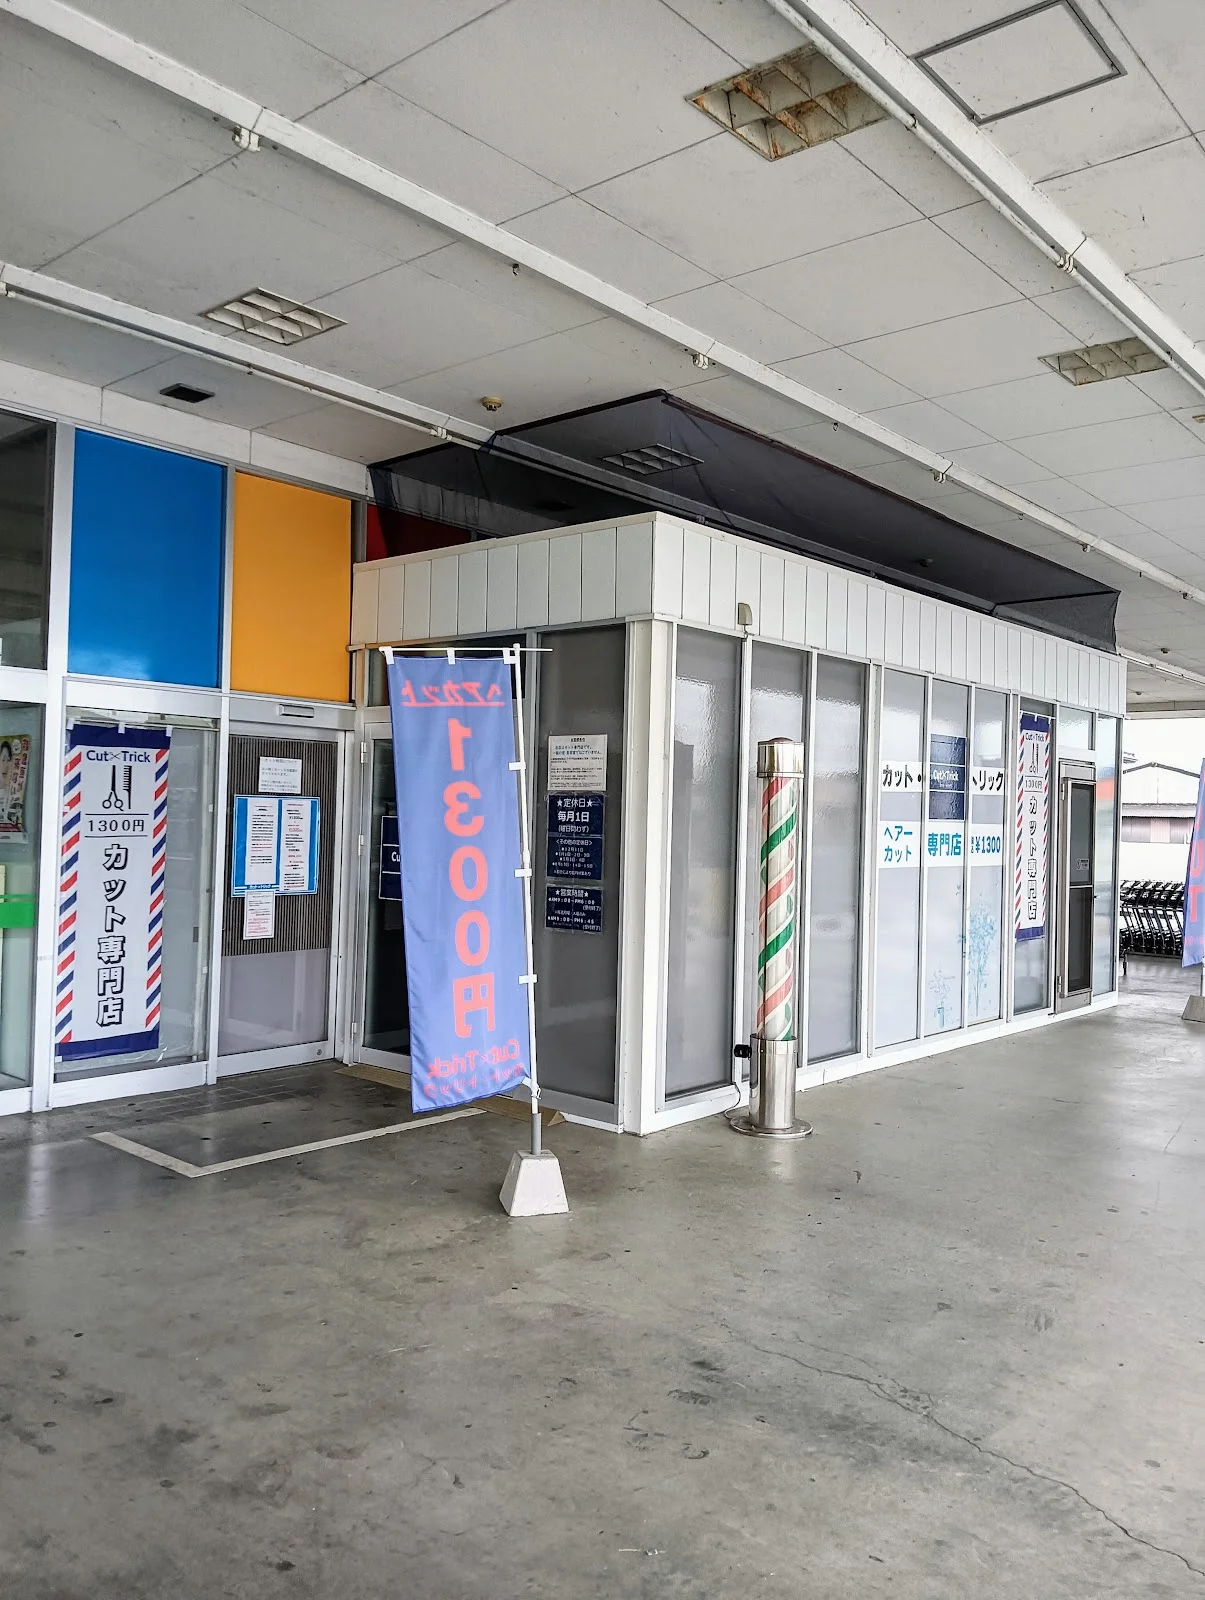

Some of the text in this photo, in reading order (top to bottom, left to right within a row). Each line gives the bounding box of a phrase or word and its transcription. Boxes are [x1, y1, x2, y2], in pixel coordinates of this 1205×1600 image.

[563, 798, 586, 808] 定休日
[557, 810, 590, 822] 毎月1日
[88, 819, 145, 832] 1300円
[883, 825, 913, 841] ヘアー
[927, 832, 962, 857] 専門店
[883, 845, 912, 863] カット
[96, 843, 129, 1028] カット専門店
